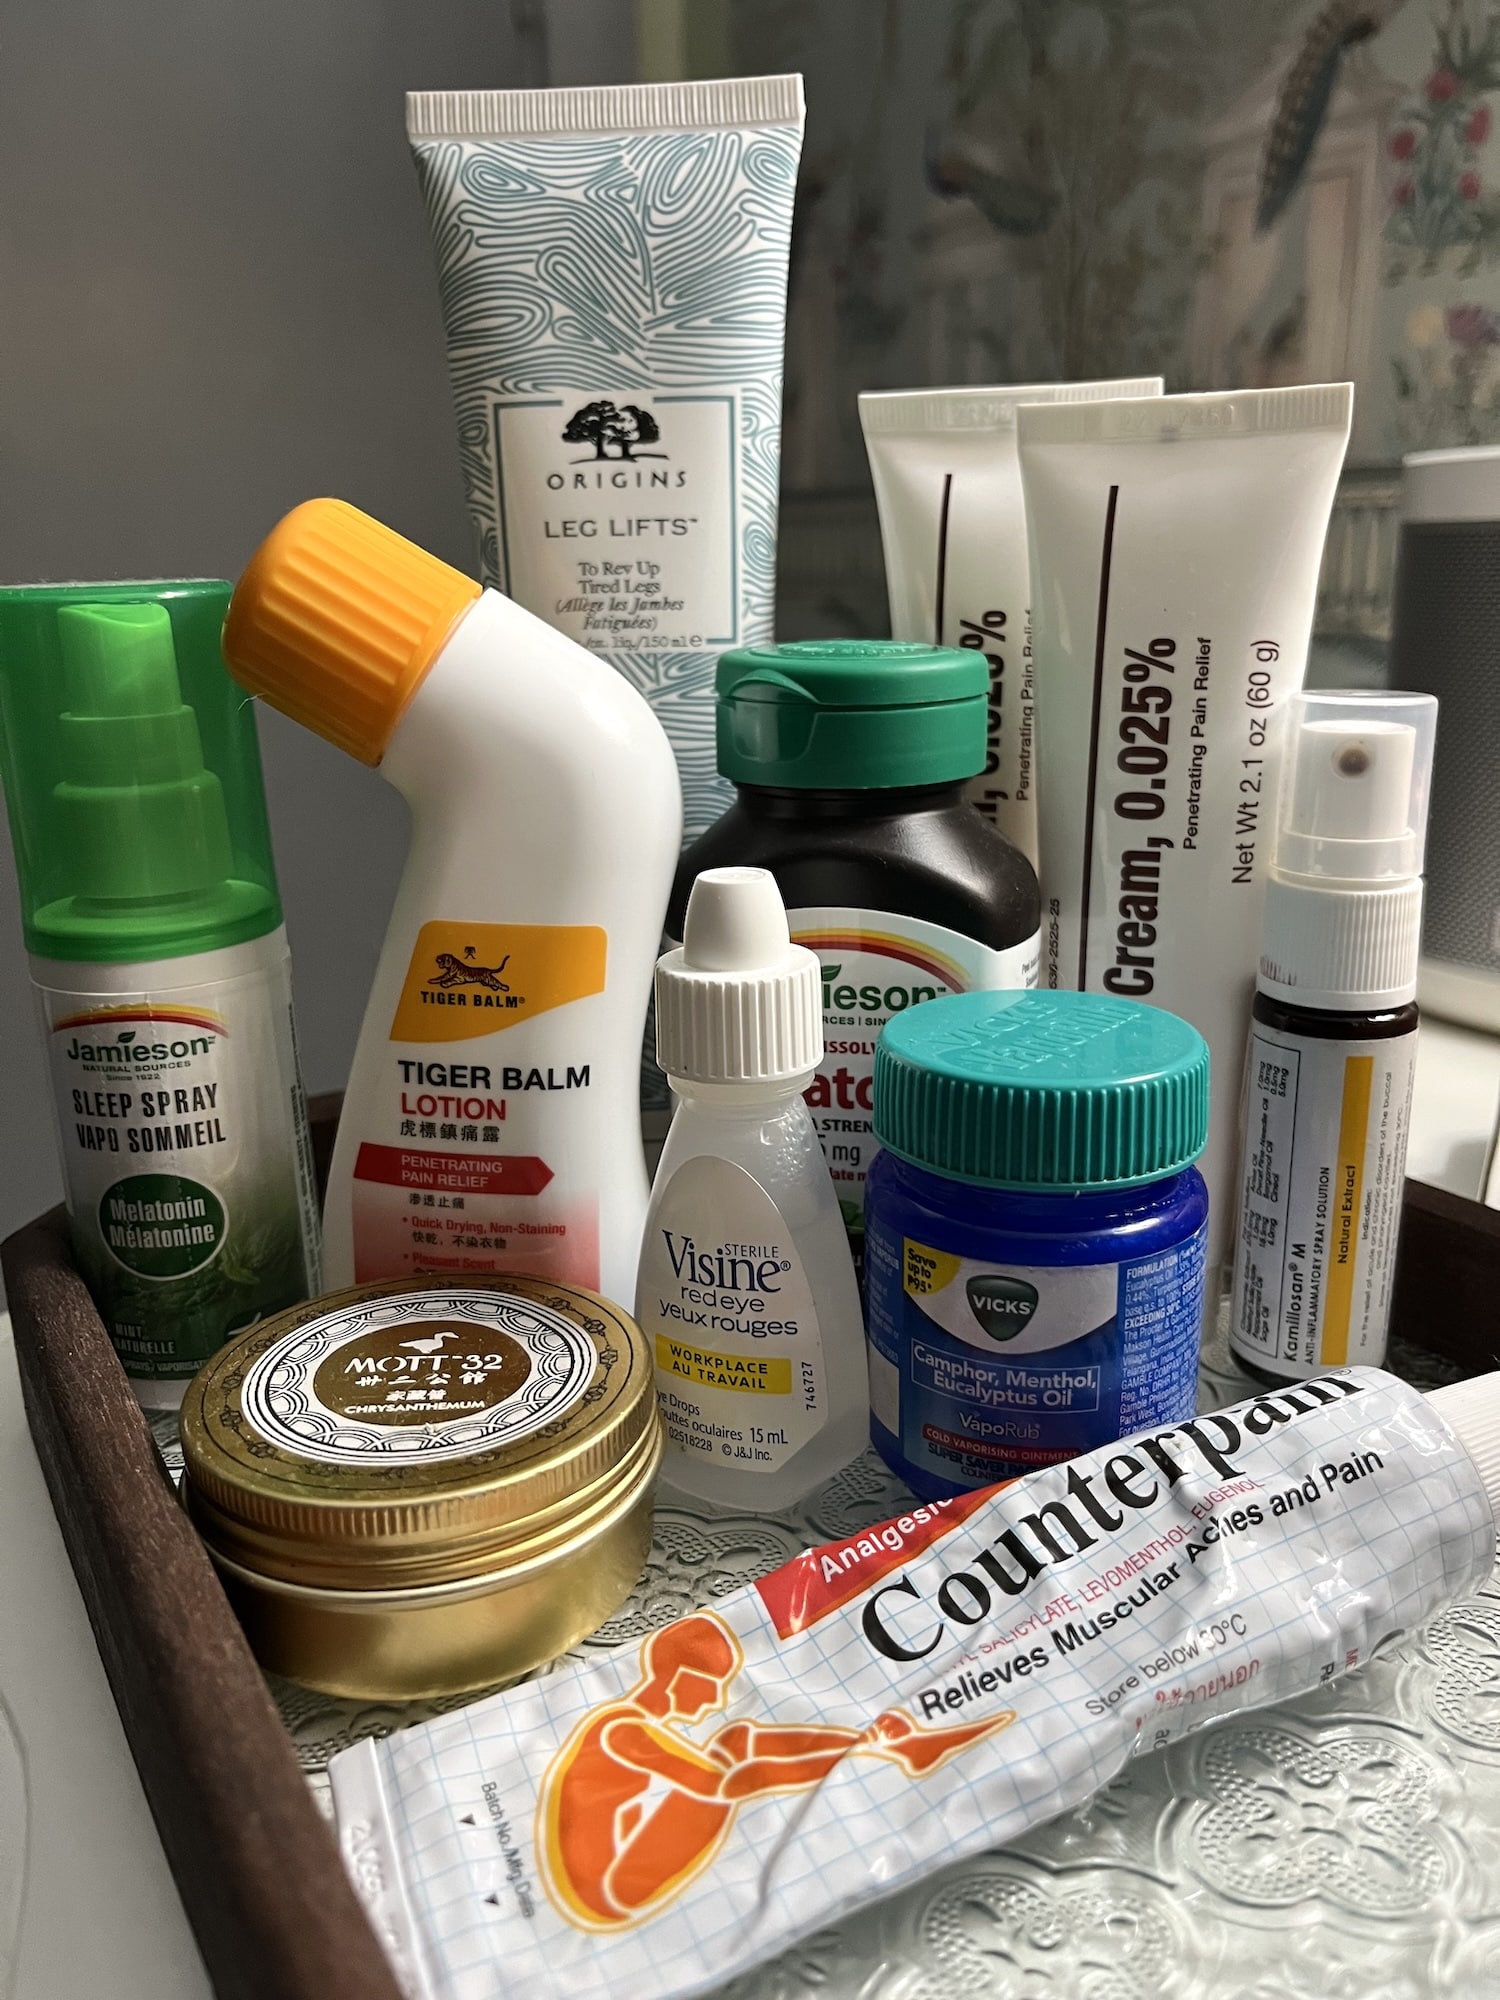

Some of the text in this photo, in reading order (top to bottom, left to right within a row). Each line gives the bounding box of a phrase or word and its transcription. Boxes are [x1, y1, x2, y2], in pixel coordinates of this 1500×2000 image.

[546, 470, 687, 490] ORIGINS
[544, 519, 598, 538] LEG
[578, 561, 661, 579] To Rev Up
[578, 580, 661, 597] Tired Legs
[608, 598, 628, 611] les
[628, 597, 685, 615] Jambes
[1017, 704, 1034, 801] Penetrating
[1183, 637, 1212, 850] Penetrating Pain Relief
[1230, 639, 1280, 884] Net Wt 2.1 oz (60 g)
[1103, 637, 1177, 996] Cream, 0.025%
[420, 991, 467, 1006] TIGER
[82, 1060, 192, 1073] NATURAL SOURCES
[106, 1073, 161, 1082] Since 1922
[397, 1059, 590, 1091] TIGER BALM
[72, 1083, 219, 1119] SLEEP SPRAY
[1382, 1071, 1392, 1108] buccal
[401, 1092, 507, 1121] LOTION
[76, 1118, 226, 1153] VAPO SOMMEIL
[401, 1154, 503, 1175] PENETRATING
[832, 1143, 860, 1166] mg
[401, 1171, 489, 1189] PAIN RELIEF
[110, 1196, 206, 1223] Melatonin
[1337, 1165, 1357, 1265] Natural Extract
[1361, 1189, 1373, 1240] Indication:
[109, 1219, 215, 1250] Mélatonine
[411, 1216, 567, 1236] Quick Drying, Non-Staining
[724, 1243, 780, 1258] STERILE
[907, 1247, 937, 1270] Save
[1295, 1243, 1306, 1260] M
[1303, 1165, 1330, 1365] ANTI-INFLAMMATORY SPRAY SOLUTION
[1126, 1254, 1179, 1280] FORMULATION
[659, 1298, 798, 1338] yeux rouges
[971, 1294, 1031, 1315] VICKS
[1124, 1306, 1166, 1330] EXCEEDING
[113, 1337, 176, 1354] NATURELLE
[669, 1343, 769, 1375] WORKPLACE
[672, 1360, 766, 1389] AU TRAVAIL
[912, 1344, 1097, 1390] Camphor, Menthol,
[1121, 1371, 1153, 1391] GAMBLE
[801, 1361, 817, 1411] 746727
[933, 1370, 1072, 1407] Eucalyptus Oil
[344, 1400, 486, 1414] CHRYSANTHEMUM
[669, 1393, 700, 1416] Drops
[691, 1420, 789, 1445] oculaires 15 mL
[959, 1411, 1041, 1440] VapoRub
[733, 1445, 753, 1460] J&J
[754, 1448, 773, 1461] Inc.
[926, 1427, 950, 1444] COLD
[953, 1438, 1017, 1460] VAPORISING
[927, 1442, 964, 1466] SUPER
[965, 1455, 1006, 1474] SAVER
[862, 1376, 1364, 1663] Counterpain
[1084, 1525, 1198, 1602] LEVOMENTHOL,
[1191, 1477, 1266, 1520] EUGENOL
[917, 1645, 1050, 1720] Relieves
[1050, 1559, 1181, 1657] Muscular
[1184, 1504, 1264, 1563] Aches
[1269, 1475, 1321, 1518] and
[1320, 1450, 1384, 1492] Pain
[1086, 1673, 1139, 1717] Store
[1138, 1637, 1200, 1679] below
[481, 1780, 504, 1822] Batch
